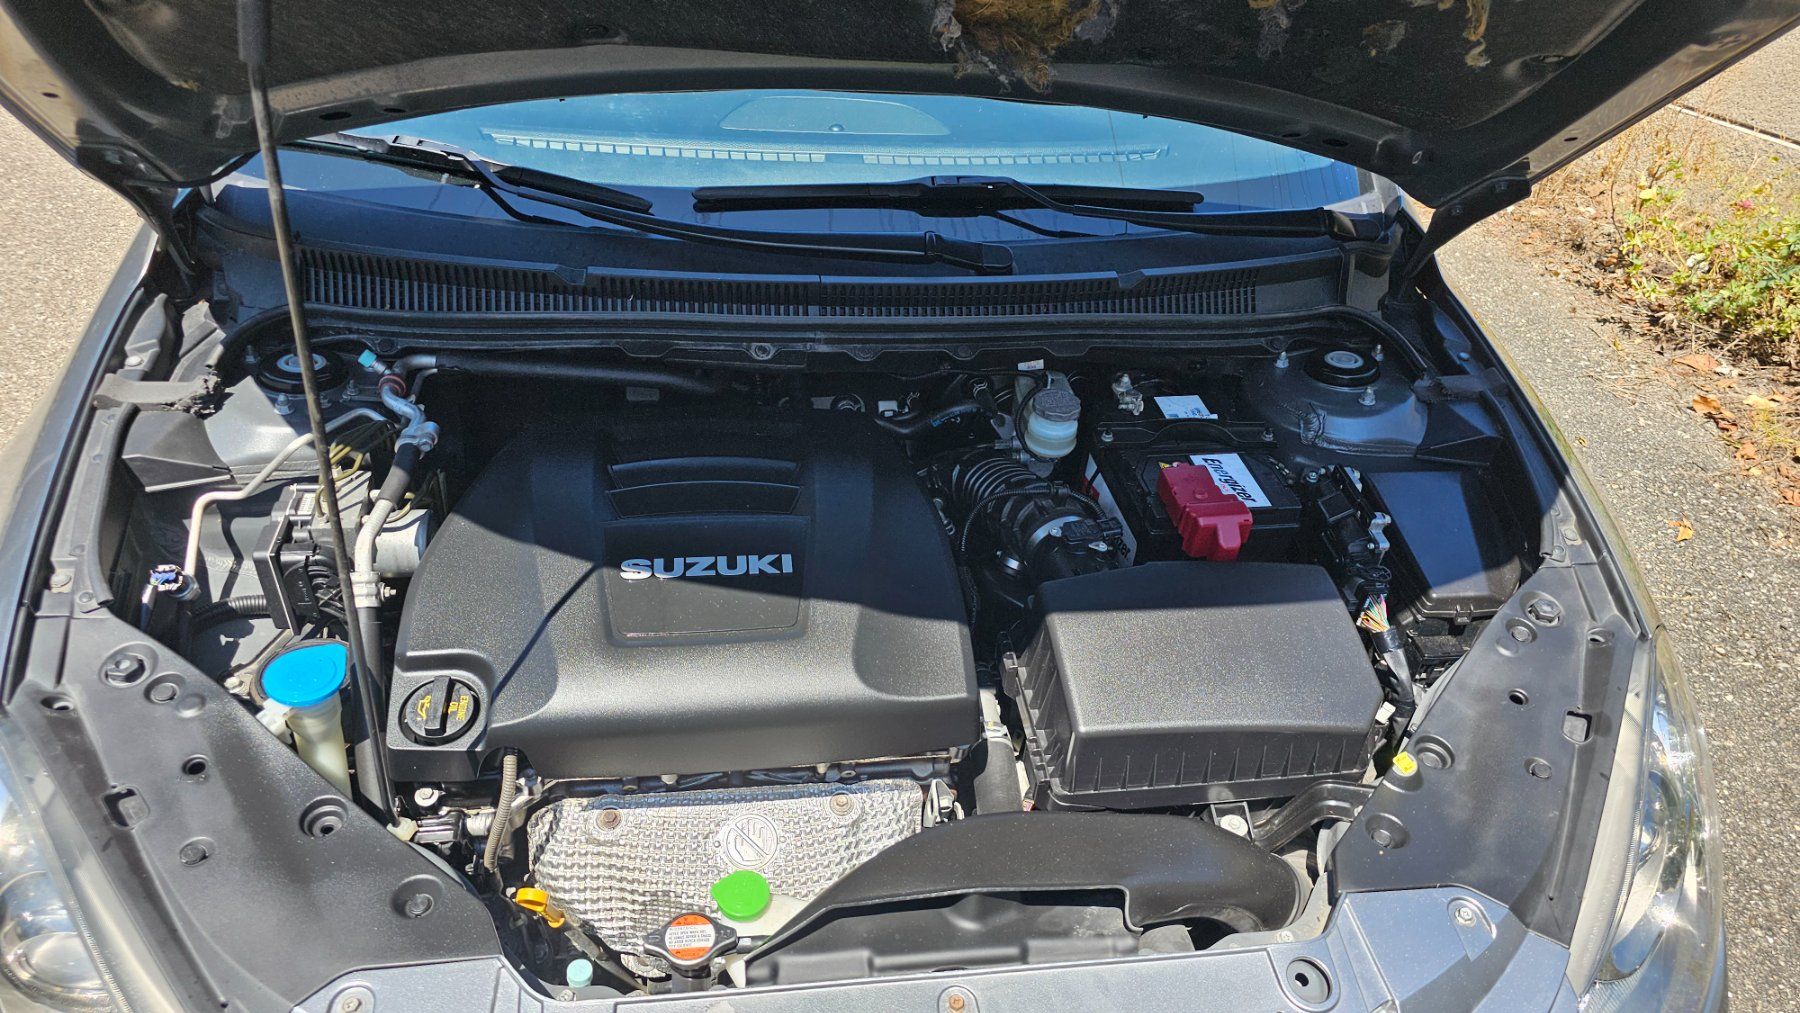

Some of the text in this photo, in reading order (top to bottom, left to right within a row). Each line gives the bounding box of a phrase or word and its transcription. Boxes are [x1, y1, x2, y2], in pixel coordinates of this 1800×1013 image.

[1201, 457, 1257, 503] Energizer
[619, 553, 794, 580] SUZUKI
[447, 701, 459, 715] OIL
[456, 695, 469, 721] ENGINE
